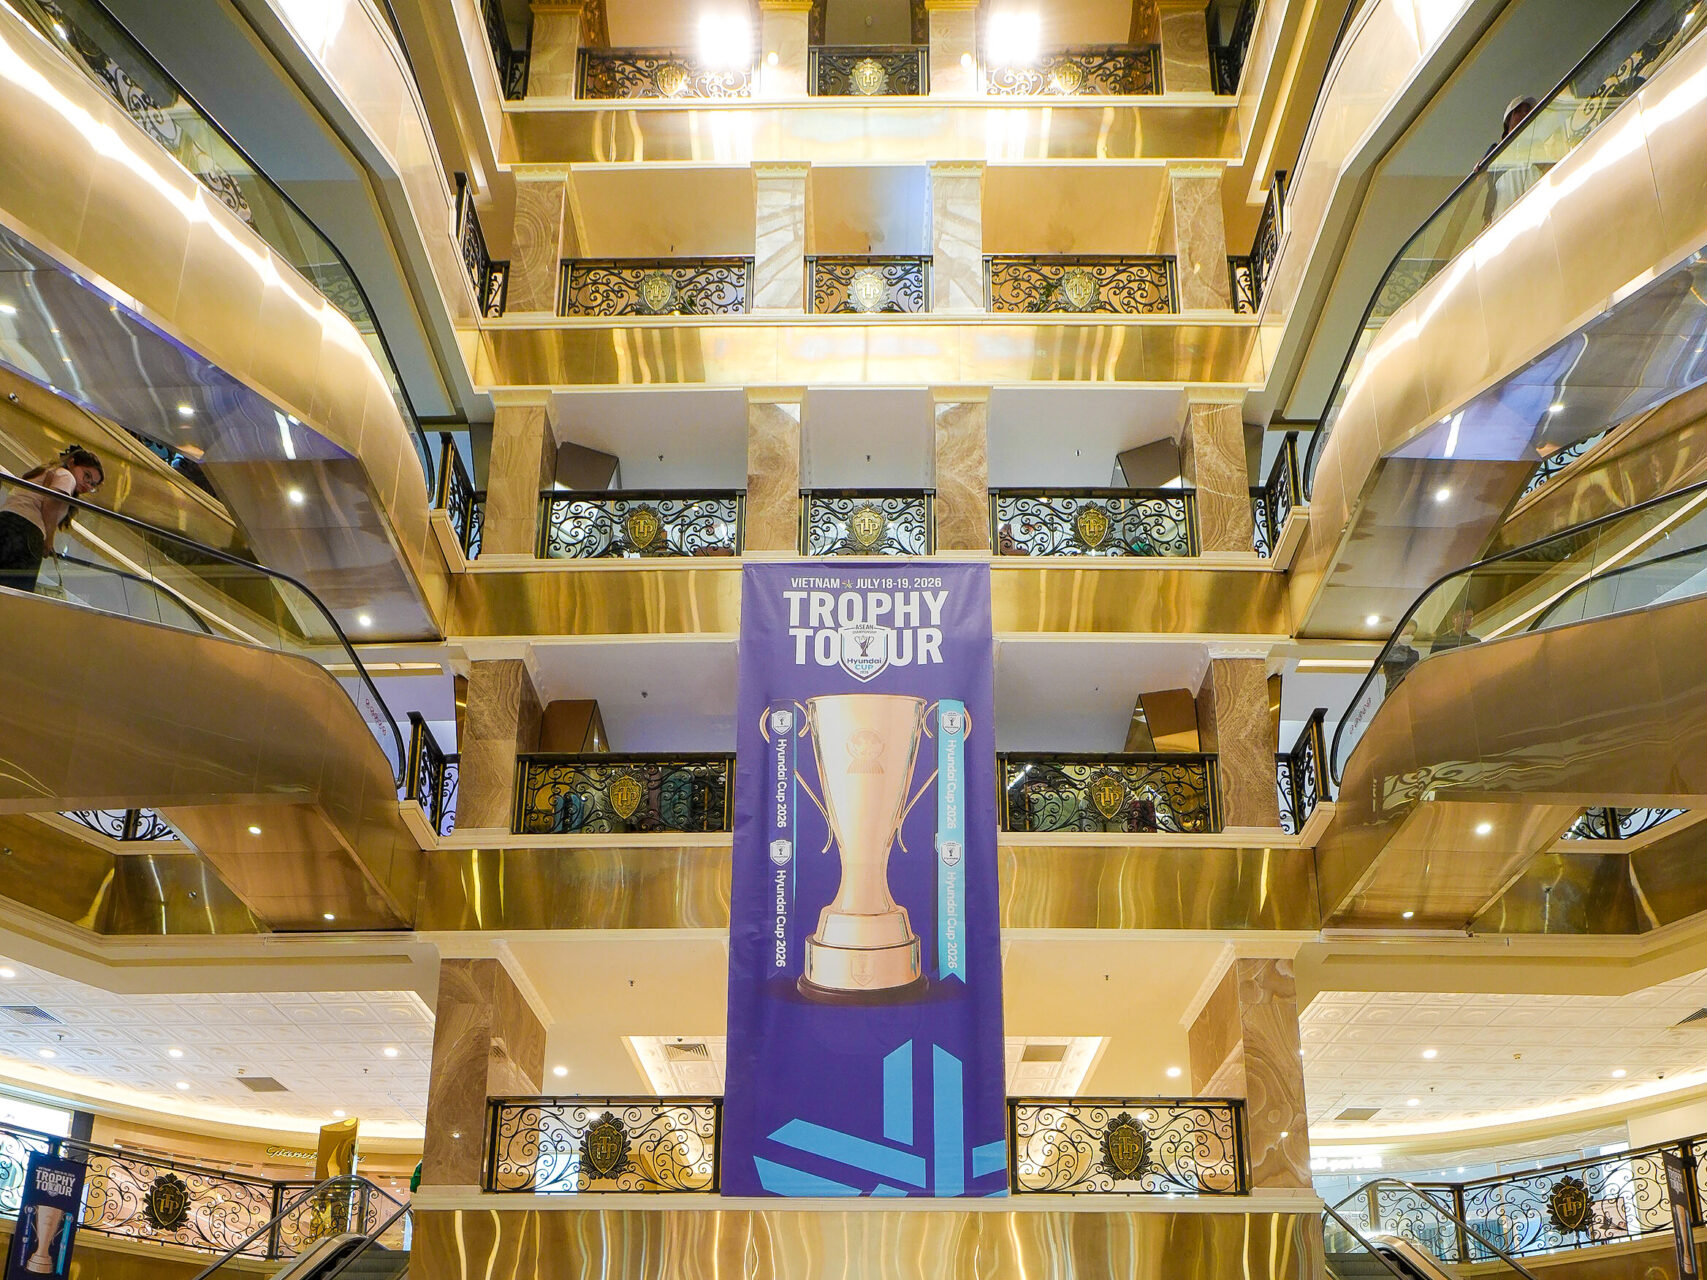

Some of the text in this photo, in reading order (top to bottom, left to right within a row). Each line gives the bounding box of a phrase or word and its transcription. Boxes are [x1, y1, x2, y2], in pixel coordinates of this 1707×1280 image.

[791, 577, 840, 588] VIETNAM
[856, 578, 880, 589] JULY
[914, 577, 942, 588] 2026
[783, 590, 949, 628] TROPHY
[847, 657, 882, 665] Hyundai
[776, 739, 787, 780] Hyundai
[945, 740, 957, 781] Hyundai
[776, 781, 787, 802] Cup
[945, 782, 957, 803] Cup
[776, 803, 787, 828] 2026
[945, 805, 957, 829] 2026
[775, 870, 787, 914] Hyundai
[945, 871, 957, 916] Hyundai
[775, 915, 787, 939] Cup
[945, 917, 957, 940] Cup
[775, 940, 787, 967] 2026
[945, 942, 957, 969] 2026
[35, 1169, 76, 1188] TROPHY
